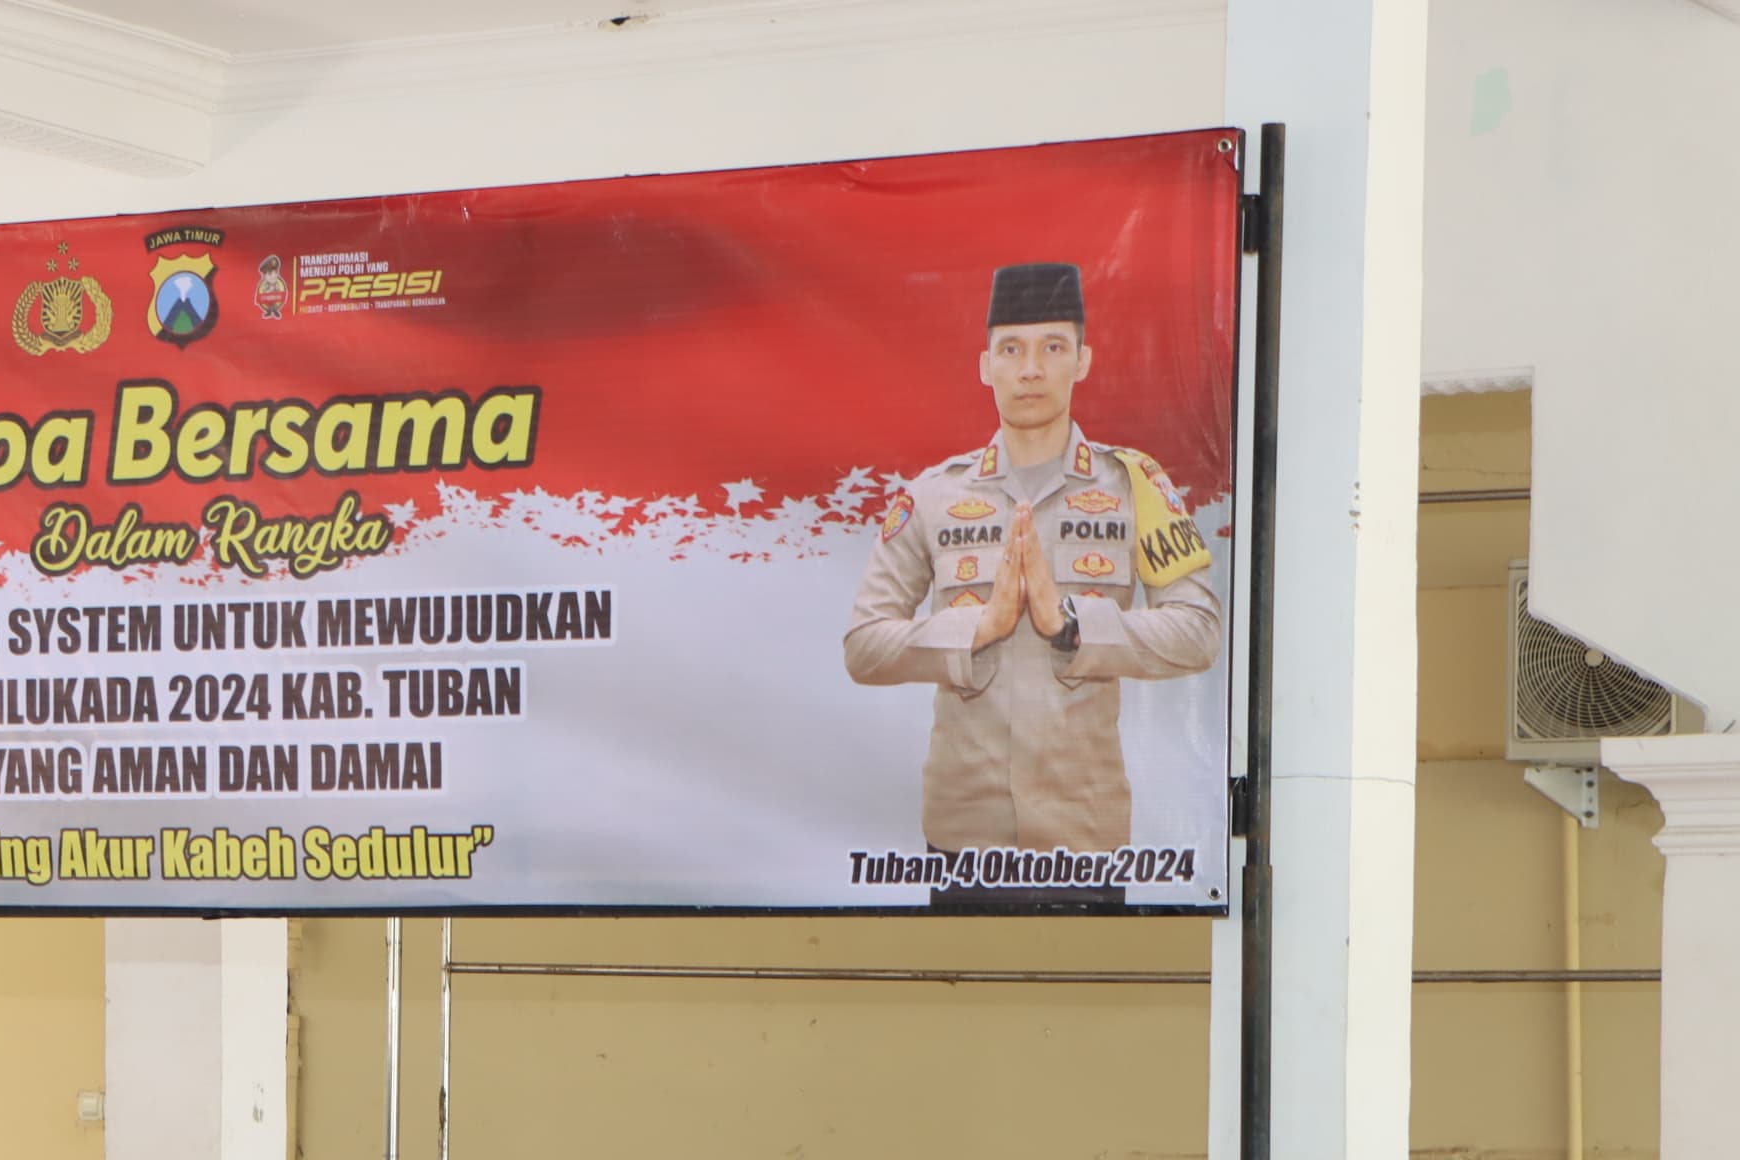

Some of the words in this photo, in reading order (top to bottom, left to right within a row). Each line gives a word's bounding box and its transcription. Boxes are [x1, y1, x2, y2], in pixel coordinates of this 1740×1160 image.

[149, 231, 181, 249] JAWA
[184, 230, 221, 245] TIMUR
[300, 252, 369, 266] TRANSFORMASI
[300, 265, 336, 278] MENUJU
[338, 263, 364, 275] POLRI
[367, 262, 389, 273] YANG
[300, 270, 443, 302] PRESISI
[110, 384, 536, 483] Bersama
[35, 508, 195, 573] Dalam
[205, 497, 389, 574] Rangka
[938, 526, 1003, 547] OSKAR
[1060, 521, 1126, 540] POLRI
[8, 604, 162, 654] SYSTEM
[173, 600, 306, 651] UNTUK
[318, 590, 613, 646] MEWUJUDKAN
[168, 673, 272, 722] 2024
[282, 670, 374, 719] KAB.
[383, 667, 521, 717] TUBAN
[92, 746, 207, 793] AMAN
[218, 744, 300, 792] DAN
[310, 742, 443, 791] DAMAI
[60, 828, 153, 879] Akur
[161, 827, 297, 880] Kabeh
[849, 851, 951, 888] Tuban,
[958, 850, 976, 883] 4
[981, 849, 1109, 883] Oktober
[1112, 848, 1196, 882] 2024
